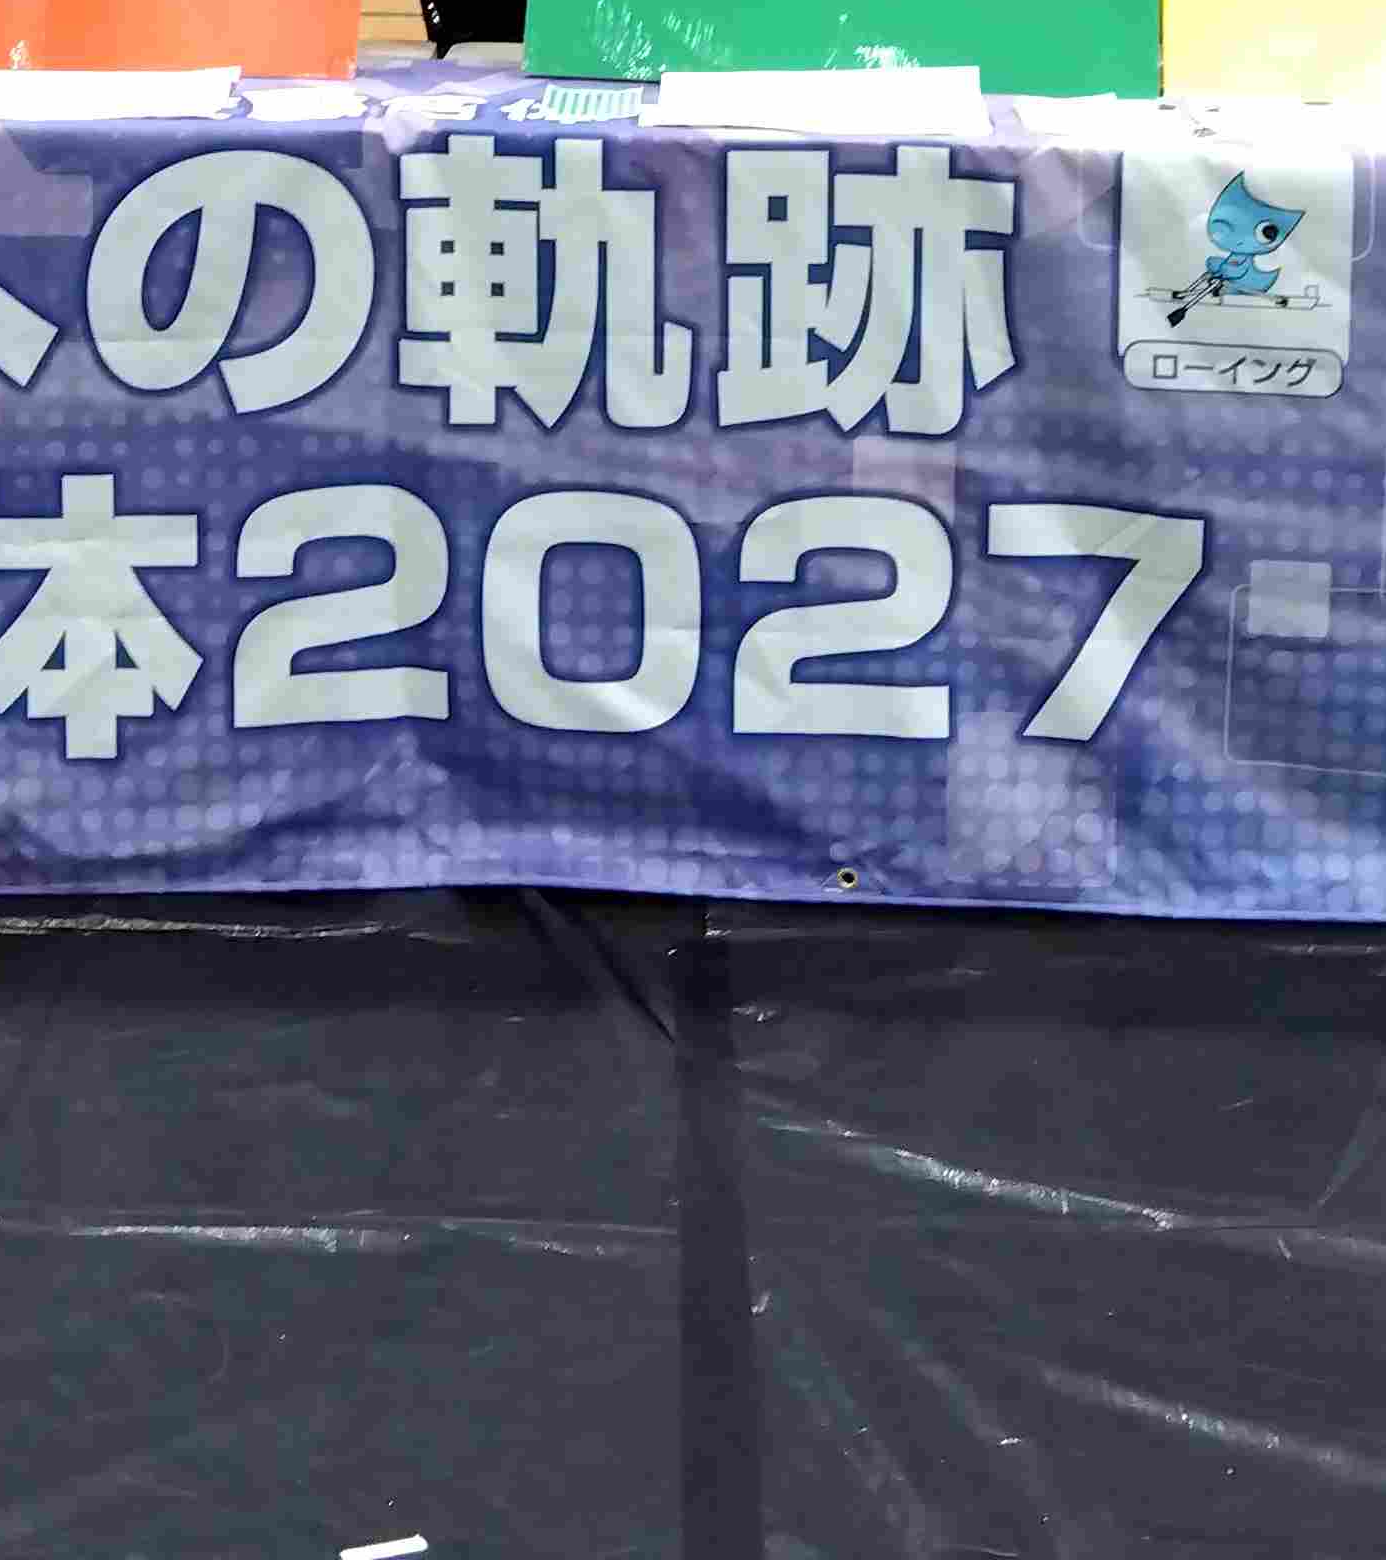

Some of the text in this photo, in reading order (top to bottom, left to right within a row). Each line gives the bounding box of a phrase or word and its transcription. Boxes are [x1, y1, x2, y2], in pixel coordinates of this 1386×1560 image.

[1151, 352, 1318, 388] ローイング
